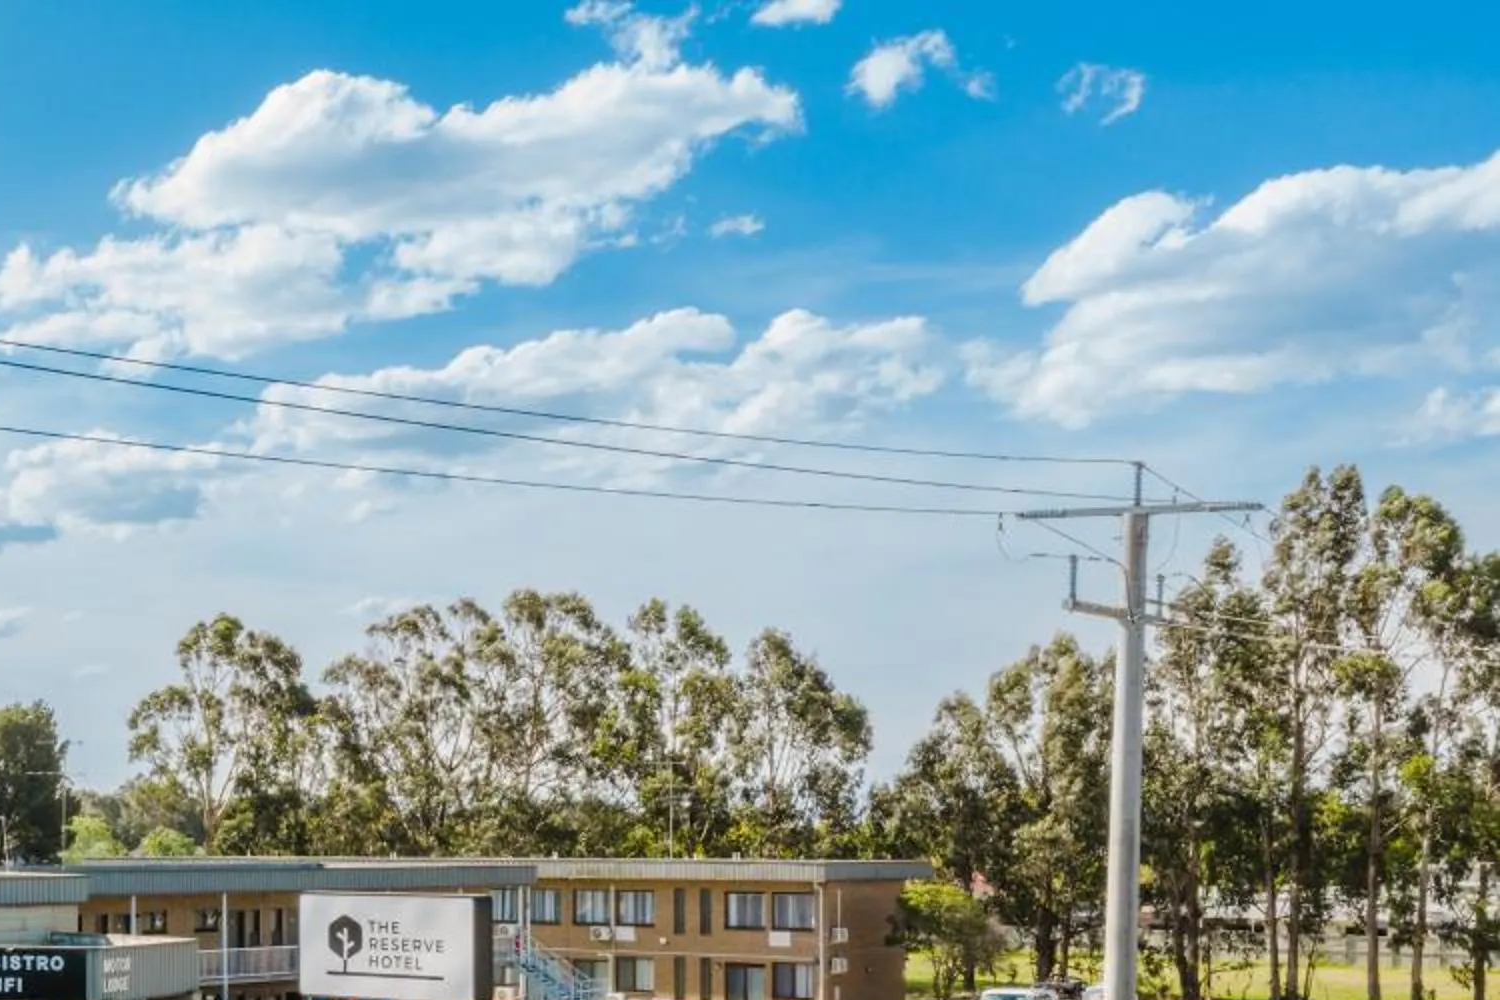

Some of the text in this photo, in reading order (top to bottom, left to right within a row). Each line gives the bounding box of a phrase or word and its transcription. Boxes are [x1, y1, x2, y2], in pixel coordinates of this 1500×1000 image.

[368, 921, 400, 935] THE
[368, 937, 445, 954] RESERVE
[368, 956, 422, 971] HOTEL
